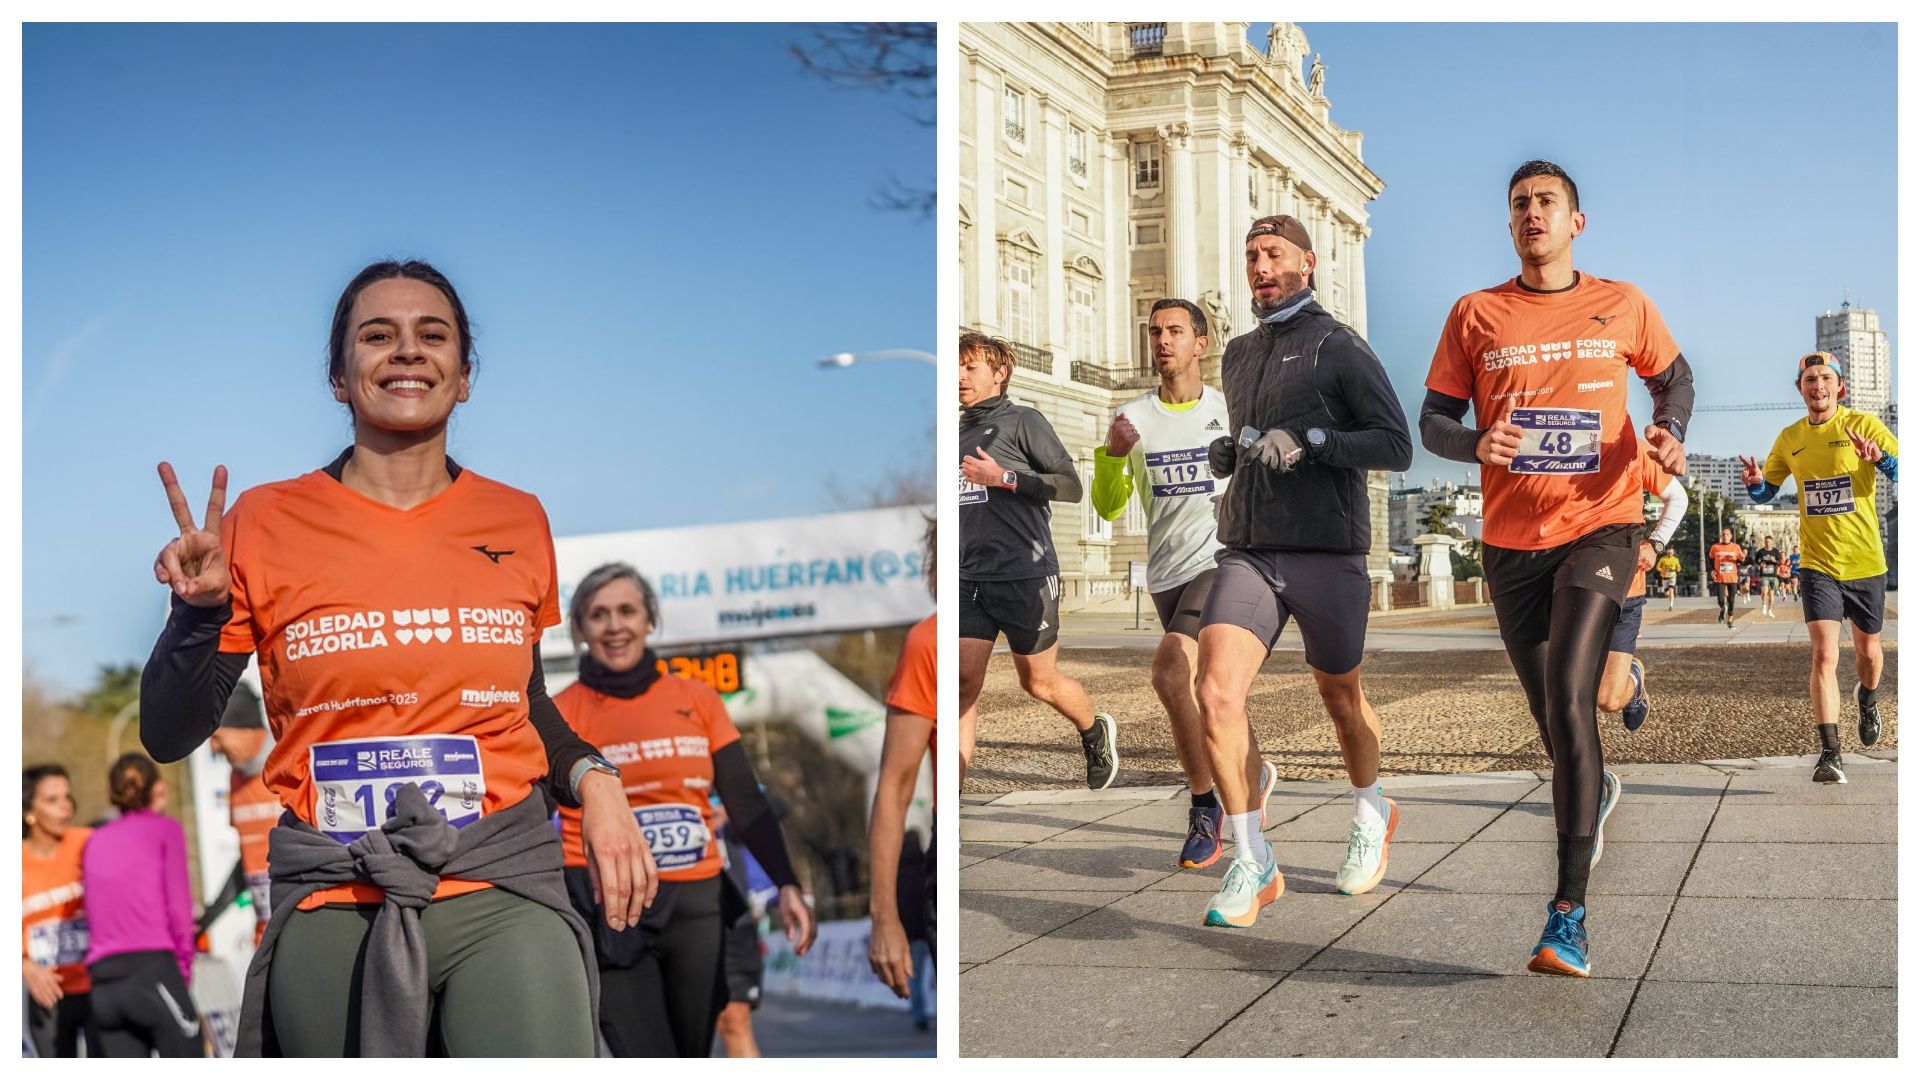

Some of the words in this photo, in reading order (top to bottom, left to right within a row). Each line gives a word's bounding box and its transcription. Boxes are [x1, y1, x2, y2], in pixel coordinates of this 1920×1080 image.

[1483, 344, 1537, 361] SOLEDAD
[1576, 339, 1616, 349] FONDO
[1485, 355, 1538, 371] CAZORLA
[1577, 348, 1615, 358] BECAS
[1539, 432, 1572, 454] 48
[1162, 464, 1198, 484] 119
[1815, 489, 1841, 505] 197
[285, 611, 385, 642] SOLEDAD
[458, 607, 525, 627] FONDO
[287, 630, 388, 662] CAZORLA
[460, 626, 524, 645] BECAS
[331, 694, 388, 711] Huérfanos
[389, 692, 418, 706] 2025
[379, 748, 433, 761] REALE
[379, 758, 434, 771] SEGUROS
[643, 825, 690, 849] 959
